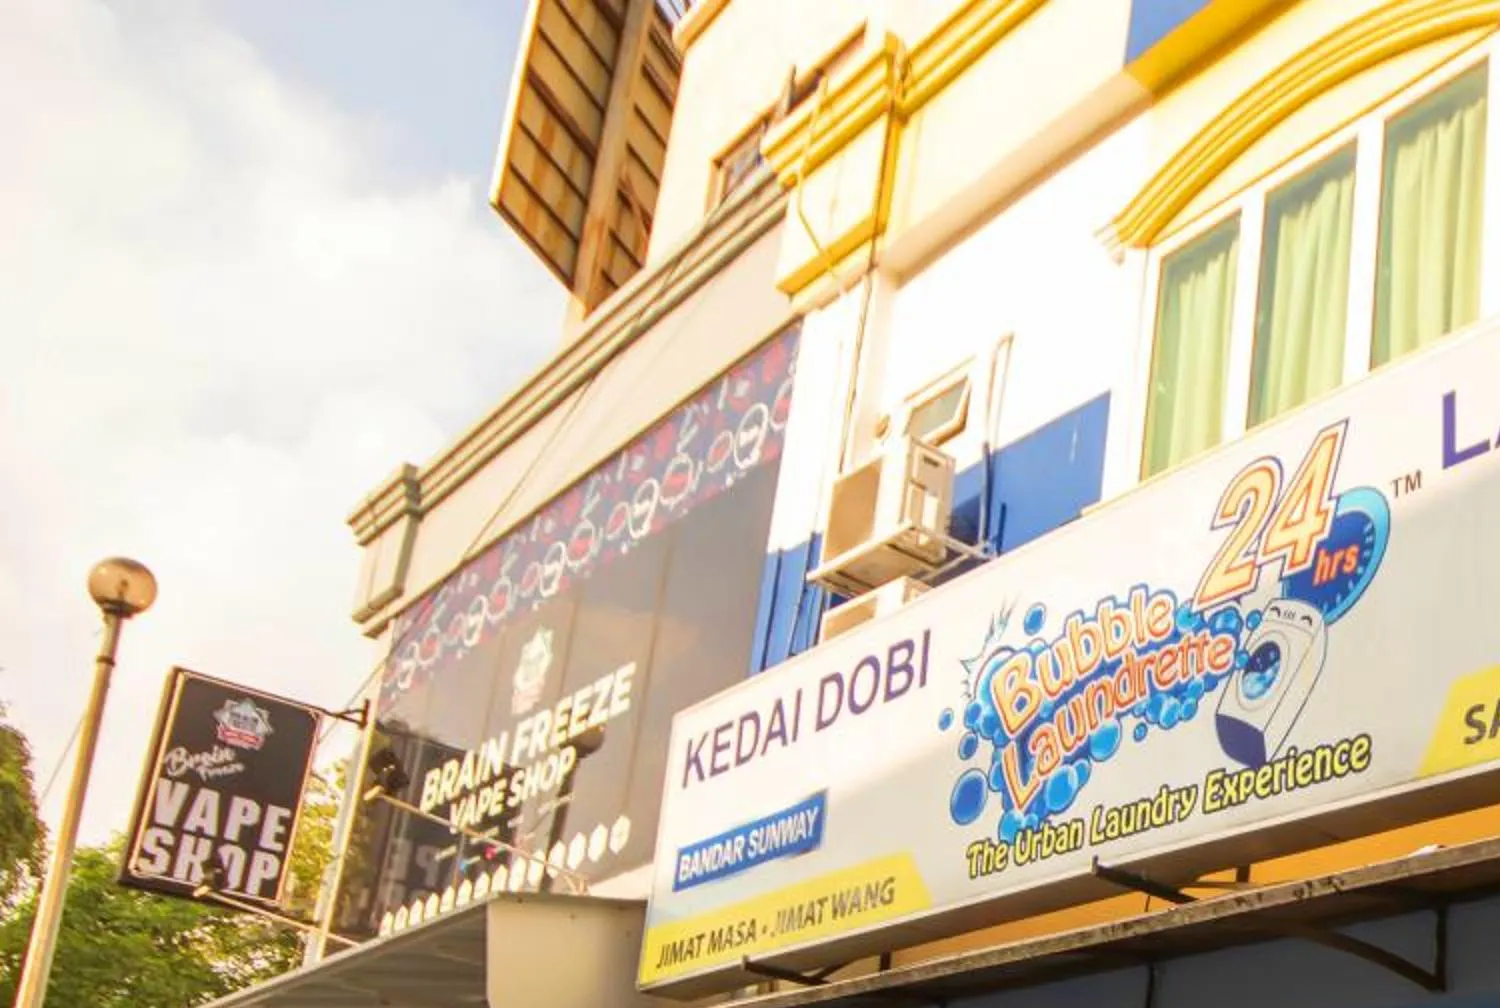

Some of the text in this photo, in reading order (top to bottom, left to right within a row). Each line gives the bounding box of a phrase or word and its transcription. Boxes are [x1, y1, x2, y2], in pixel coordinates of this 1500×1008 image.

[1192, 417, 1359, 612] 24 hrs
[1390, 468, 1423, 498] TM
[682, 629, 931, 789] KEDAI DOBI
[992, 587, 1175, 736] Bubble
[1002, 629, 1237, 812] Laundrette
[420, 730, 509, 814] BRAIN
[511, 661, 637, 767] FREEZE
[450, 745, 577, 835] VAPE SHOP
[142, 826, 281, 897] SHOP
[154, 777, 292, 851] VAPE
[679, 806, 820, 882] BANDAR SUNWAY
[966, 733, 1372, 879] The Urban Laundry Experience
[656, 876, 896, 970] JIMAT MASA JIMAT WANG
